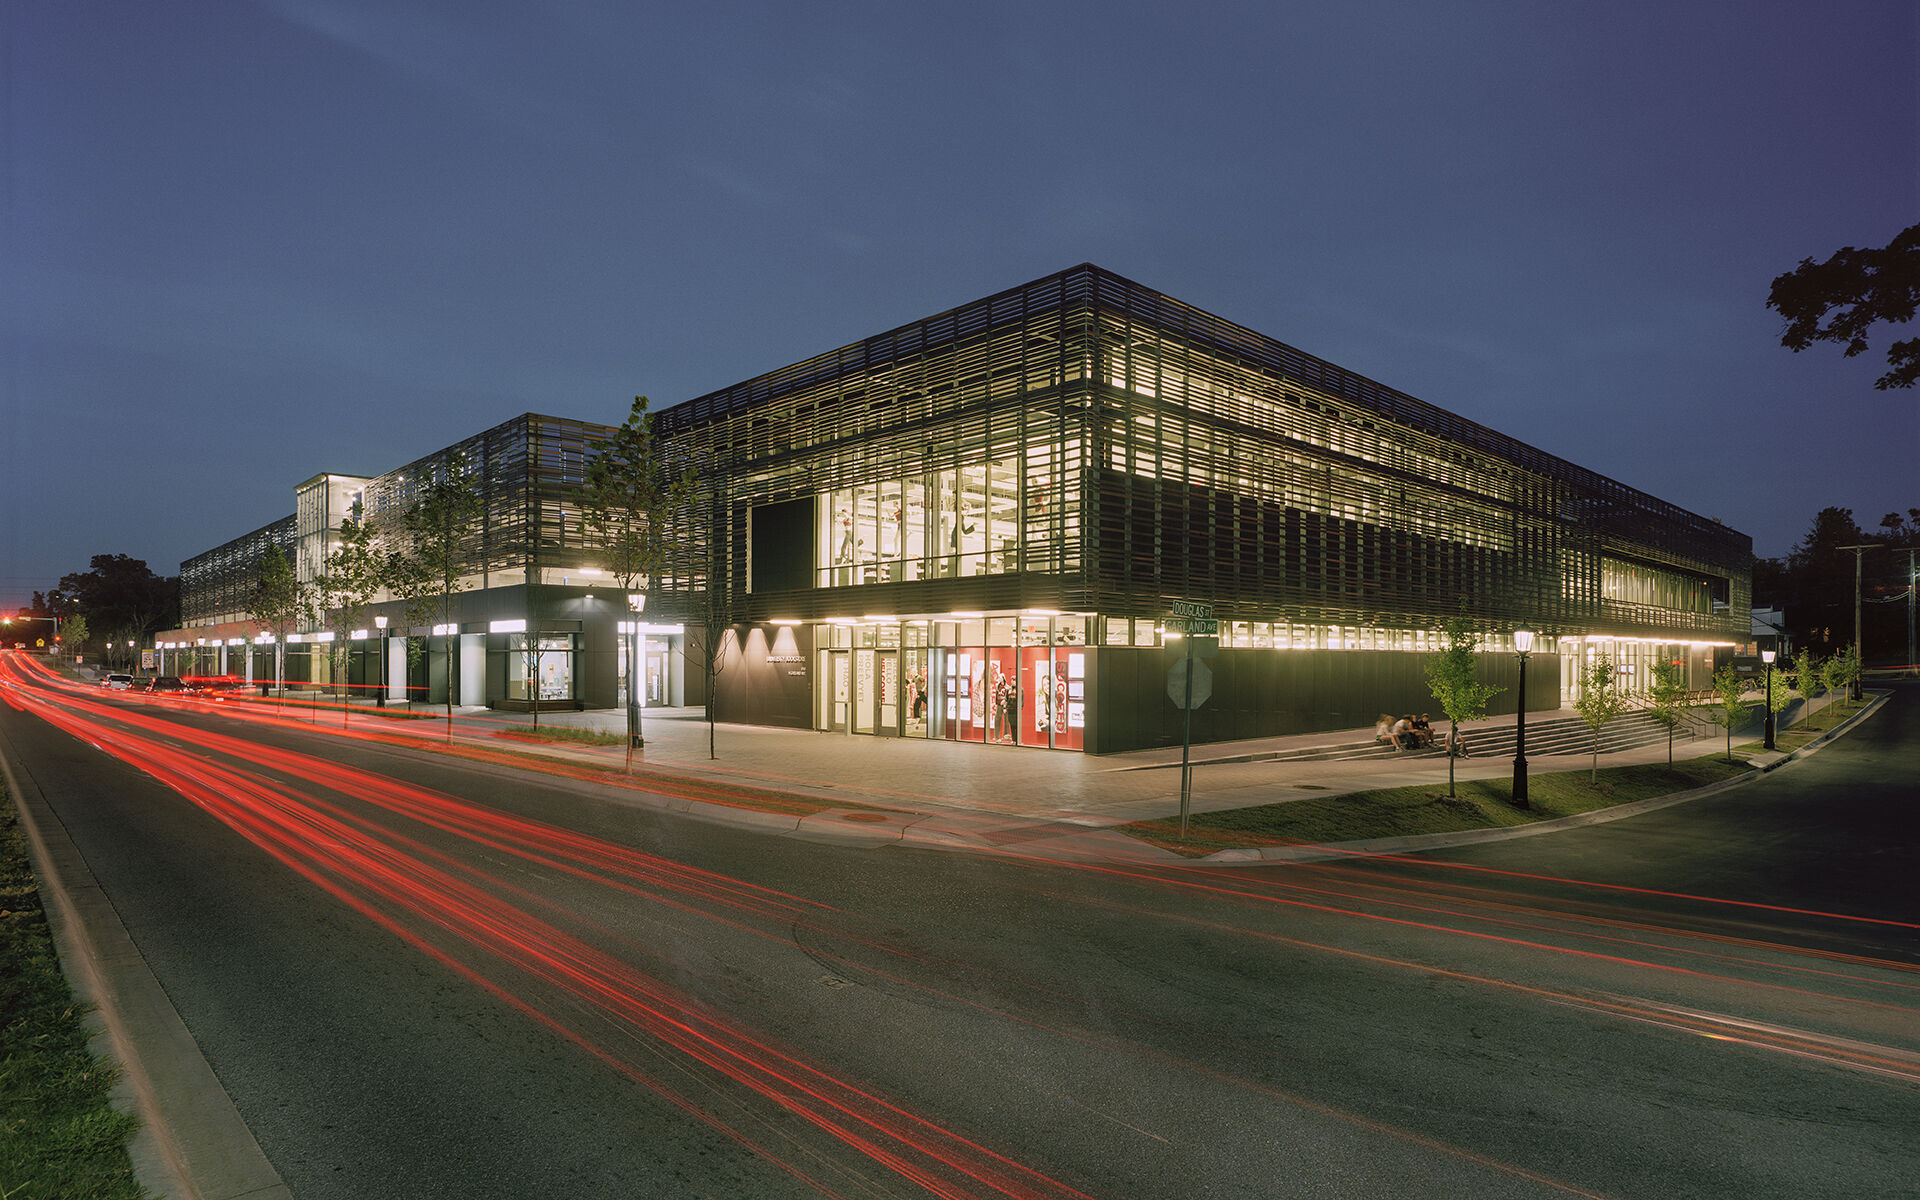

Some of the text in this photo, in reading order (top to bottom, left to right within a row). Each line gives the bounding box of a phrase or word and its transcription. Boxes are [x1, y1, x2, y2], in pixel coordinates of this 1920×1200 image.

[1175, 603, 1210, 618] DOUGLAS ST
[1166, 620, 1217, 633] GARLAND AVE
[1056, 662, 1065, 732] SUCCEED
